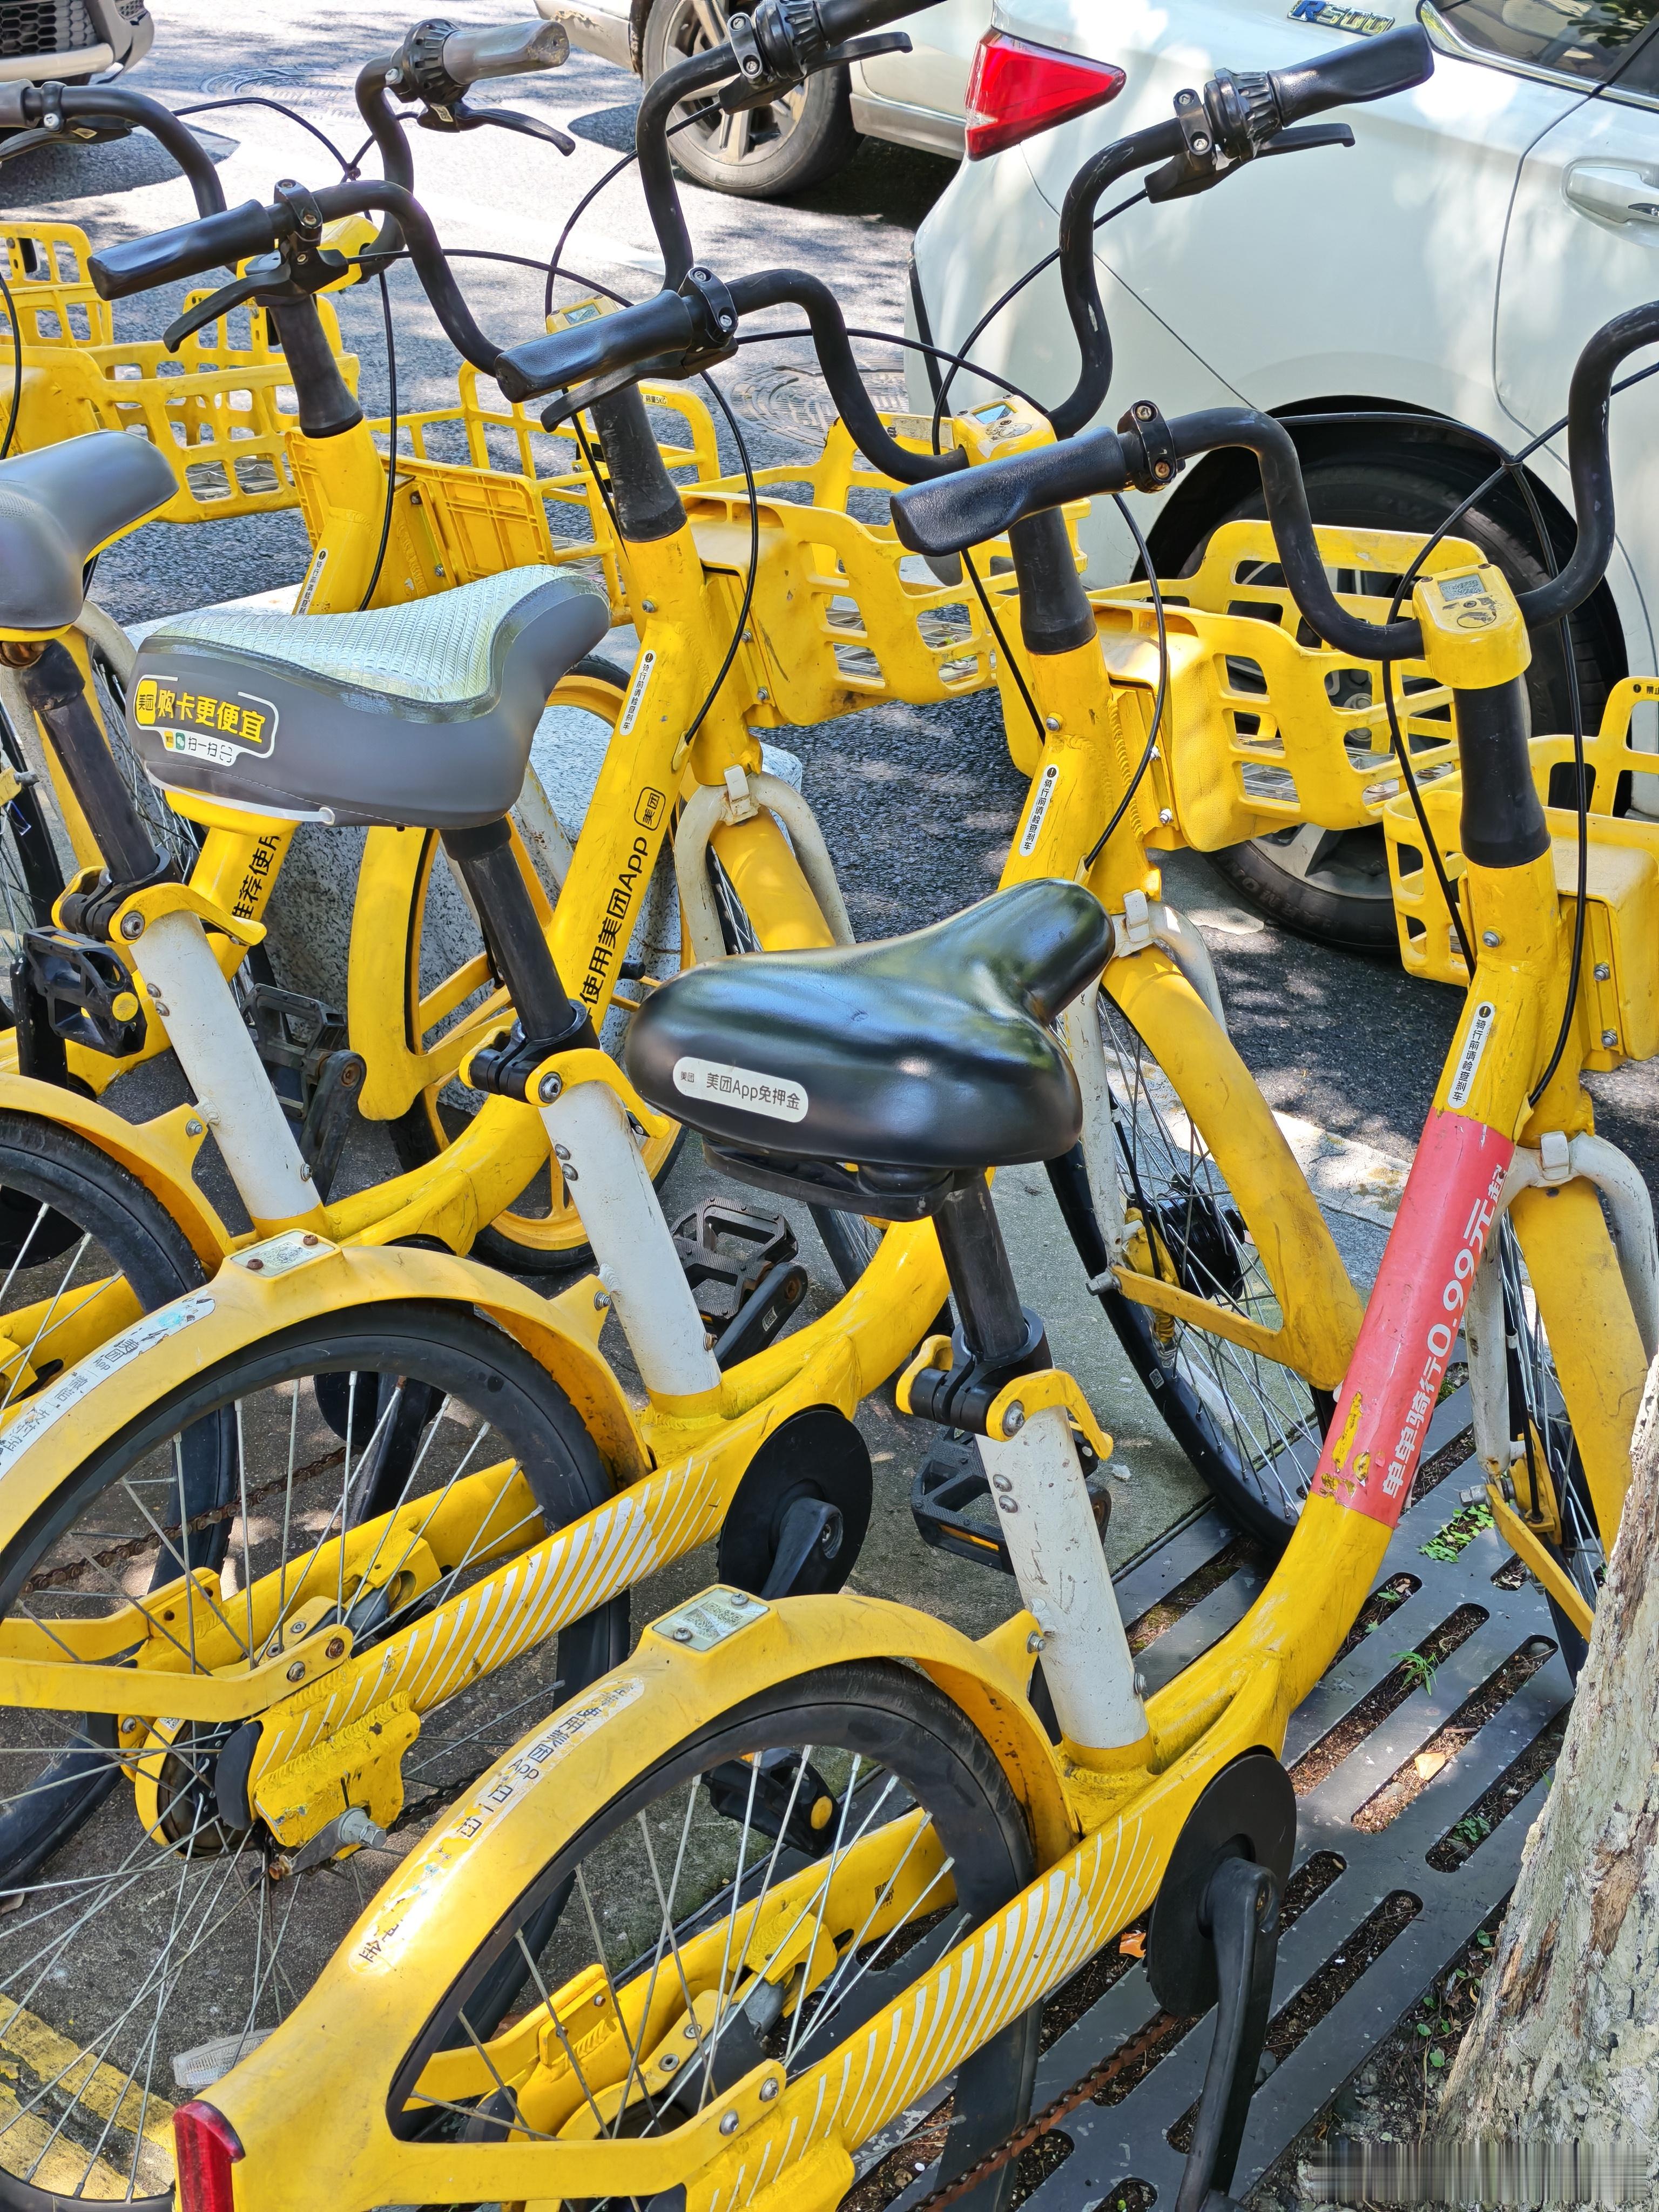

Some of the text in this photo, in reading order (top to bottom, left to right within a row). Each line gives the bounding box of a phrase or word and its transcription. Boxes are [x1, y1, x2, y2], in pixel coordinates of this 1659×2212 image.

[1292, 0, 1395, 36] R500
[157, 690, 266, 744] 购卡更便宜
[188, 737, 218, 757] 扫一扫
[1023, 779, 1053, 850] 骑行前请检查刹车
[579, 793, 660, 1019] 使用美团App 美团
[1452, 1019, 1487, 1101] 骑行前请检查刹车
[680, 1071, 800, 1110] 美团 美团App免押金
[1382, 1163, 1508, 1499] 单单骑行0.99元起
[54, 1374, 88, 1402] 微信
